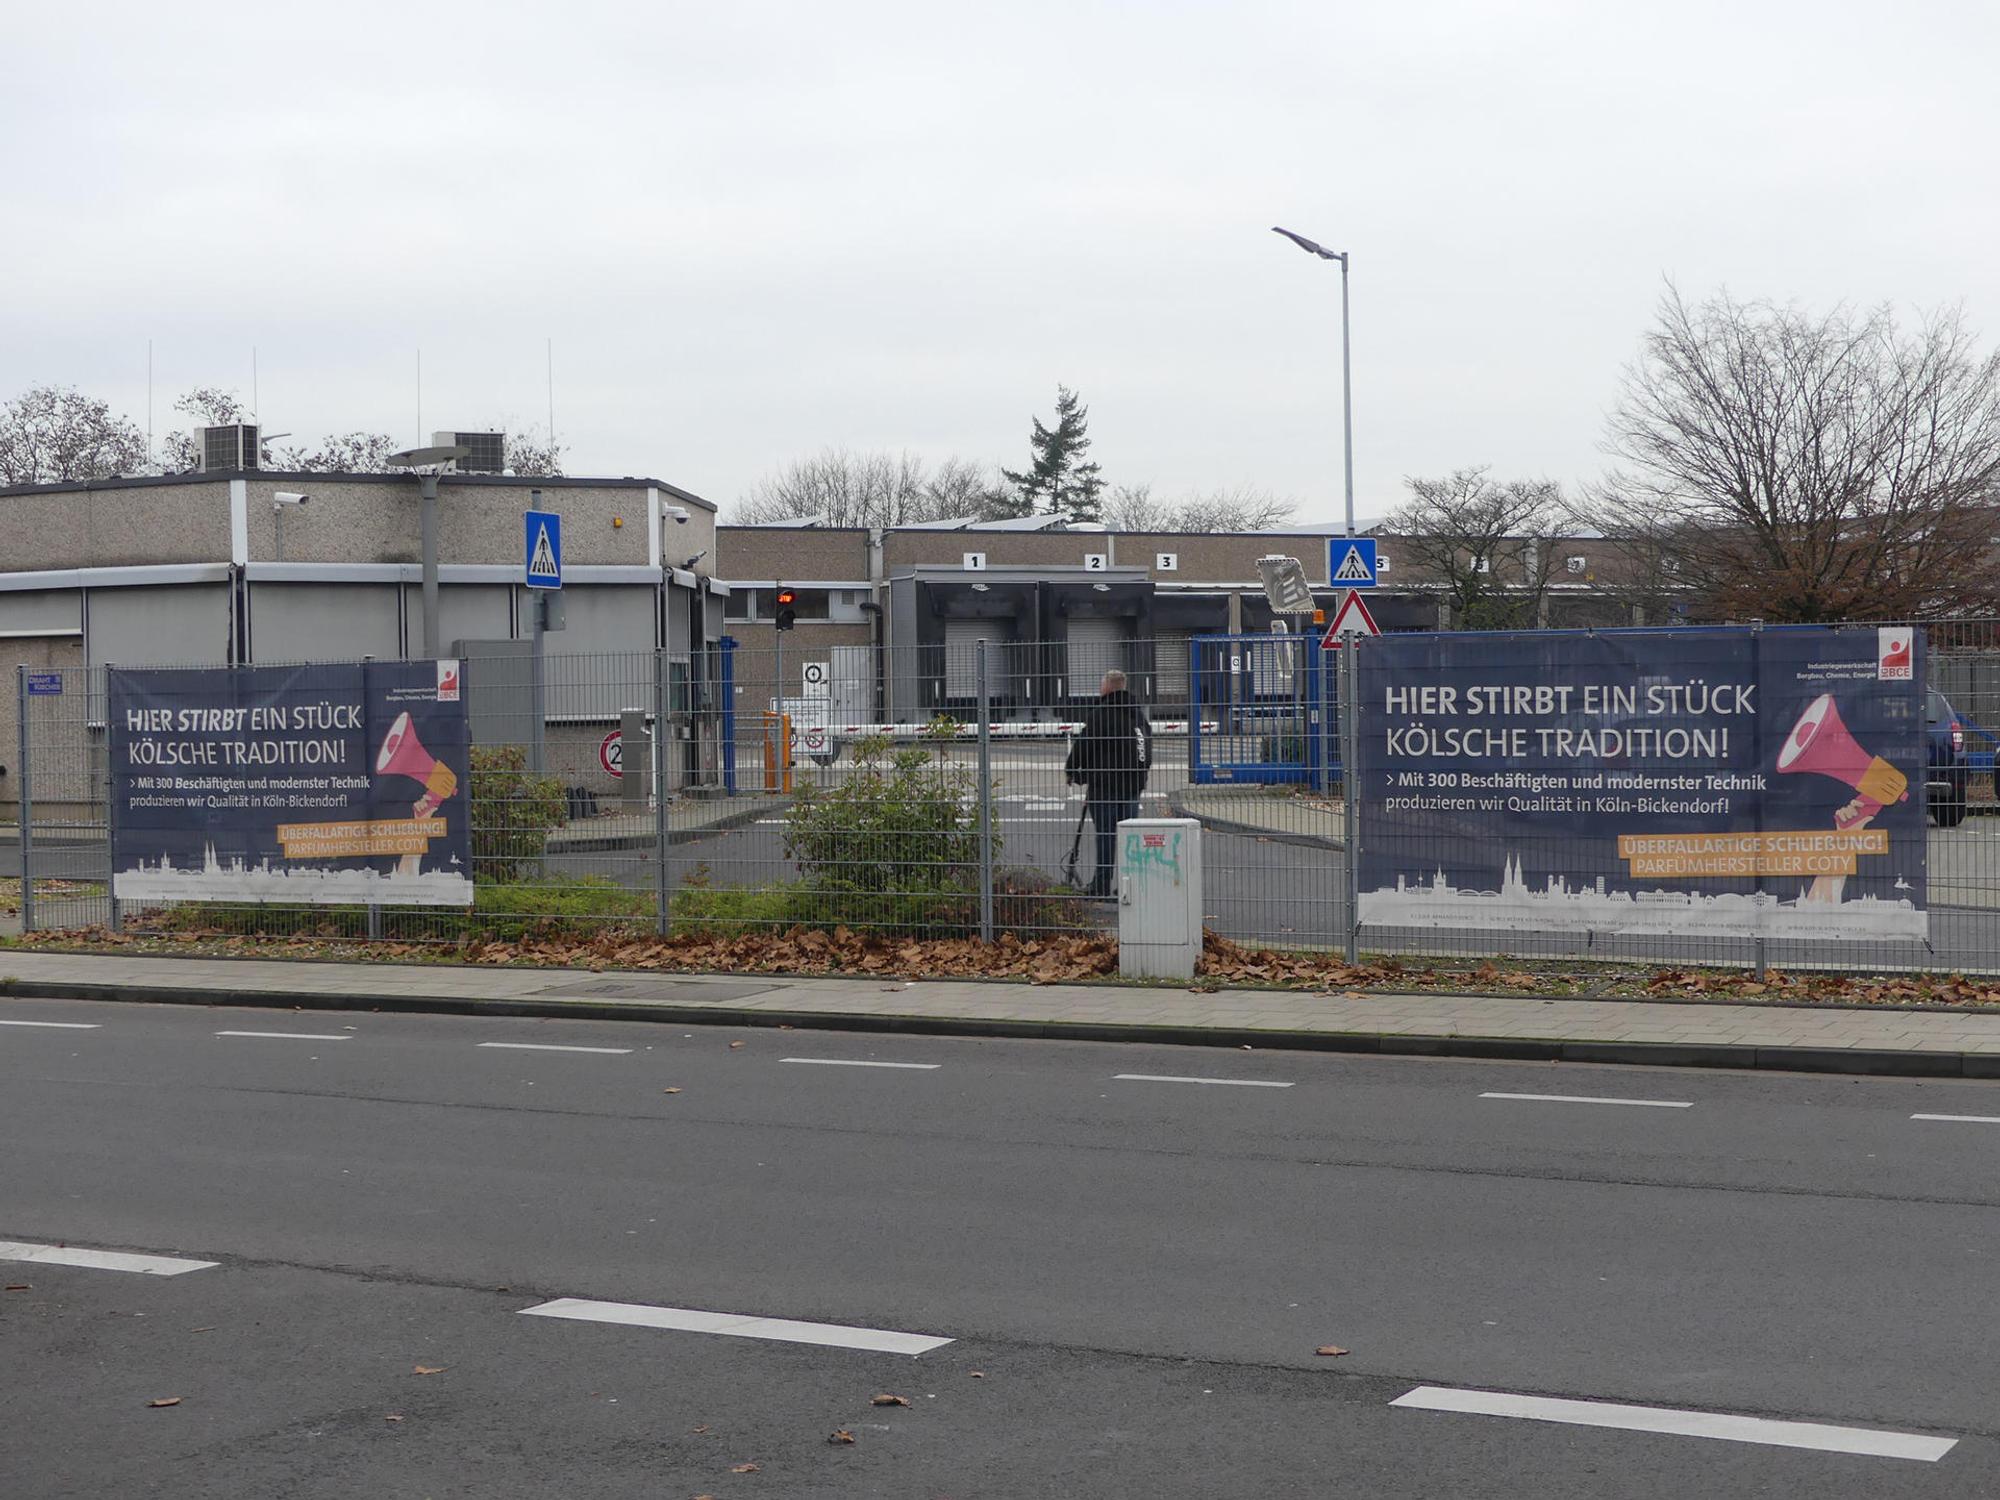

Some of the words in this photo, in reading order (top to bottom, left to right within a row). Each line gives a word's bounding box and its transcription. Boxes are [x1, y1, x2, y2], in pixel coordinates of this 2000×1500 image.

[972, 556, 978, 567] 1
[1091, 557, 1100, 568] 2
[1163, 556, 1171, 567] 3
[1889, 667, 1910, 678] BCE
[1386, 686, 1458, 714] HIER
[1466, 685, 1574, 715] STIRBT
[1584, 685, 1636, 714] EIN
[1647, 679, 1757, 715] STÜCK
[127, 709, 173, 732] HIER
[178, 708, 248, 732] STIRBT
[251, 707, 287, 731] EIN
[293, 701, 362, 730] STÜCK
[1386, 722, 1527, 757] KÖLSCHE
[1535, 727, 1729, 758] TRADITION!
[129, 737, 218, 765] KÖLSCHE
[220, 739, 345, 765] TRADITION!
[138, 777, 154, 789] Mit
[156, 777, 173, 789] 300
[175, 777, 246, 792] Beschäftigten
[248, 777, 267, 789] und
[269, 776, 329, 789] modernster
[331, 776, 370, 789] Technik
[1398, 772, 1424, 787] Mit
[1428, 773, 1457, 788] 300
[1461, 773, 1568, 793] Beschäftigten
[1572, 773, 1602, 789] und
[1607, 774, 1702, 790] modernster
[1705, 775, 1766, 790] Technik
[130, 795, 184, 809] produzieren
[187, 795, 204, 807] wir
[207, 794, 249, 808] Qualität
[251, 795, 260, 807] in
[263, 794, 347, 808] Köln-Bickendorf!
[1386, 794, 1475, 812] produzieren
[1479, 796, 1504, 810] wir
[1508, 796, 1572, 812] Qualität
[1577, 797, 1591, 812] in
[1596, 797, 1729, 814] Köln-Bickendorf!
[281, 825, 368, 840] ÜBERFALLARTIGE
[288, 839, 394, 855] PARFÜMHERSTELLER
[396, 838, 426, 852] COTY
[1624, 837, 1762, 855] ÜBERFALLARTIGE
[1636, 856, 1801, 874] PARFÜMHERSTELLER
[1806, 856, 1851, 871] COTY
